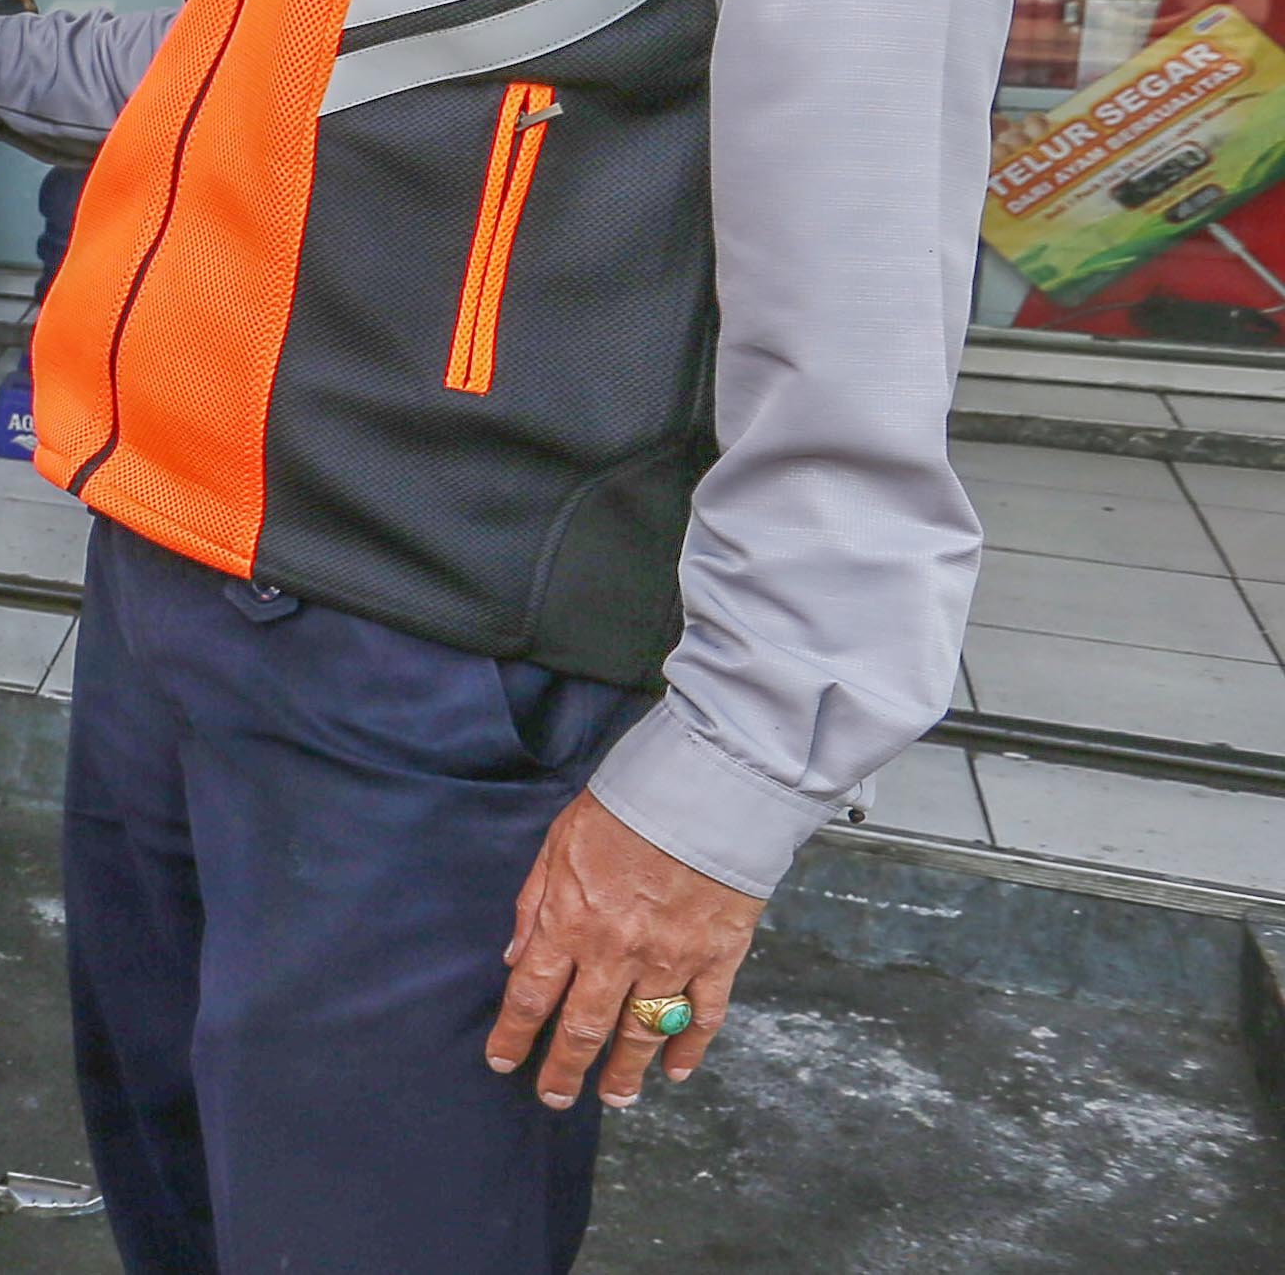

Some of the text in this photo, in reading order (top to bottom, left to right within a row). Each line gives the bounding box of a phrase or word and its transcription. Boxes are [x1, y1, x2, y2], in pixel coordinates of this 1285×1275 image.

[987, 121, 1099, 197] TELUR
[1093, 42, 1223, 127] SEGAR
[7, 413, 35, 431] AQ
